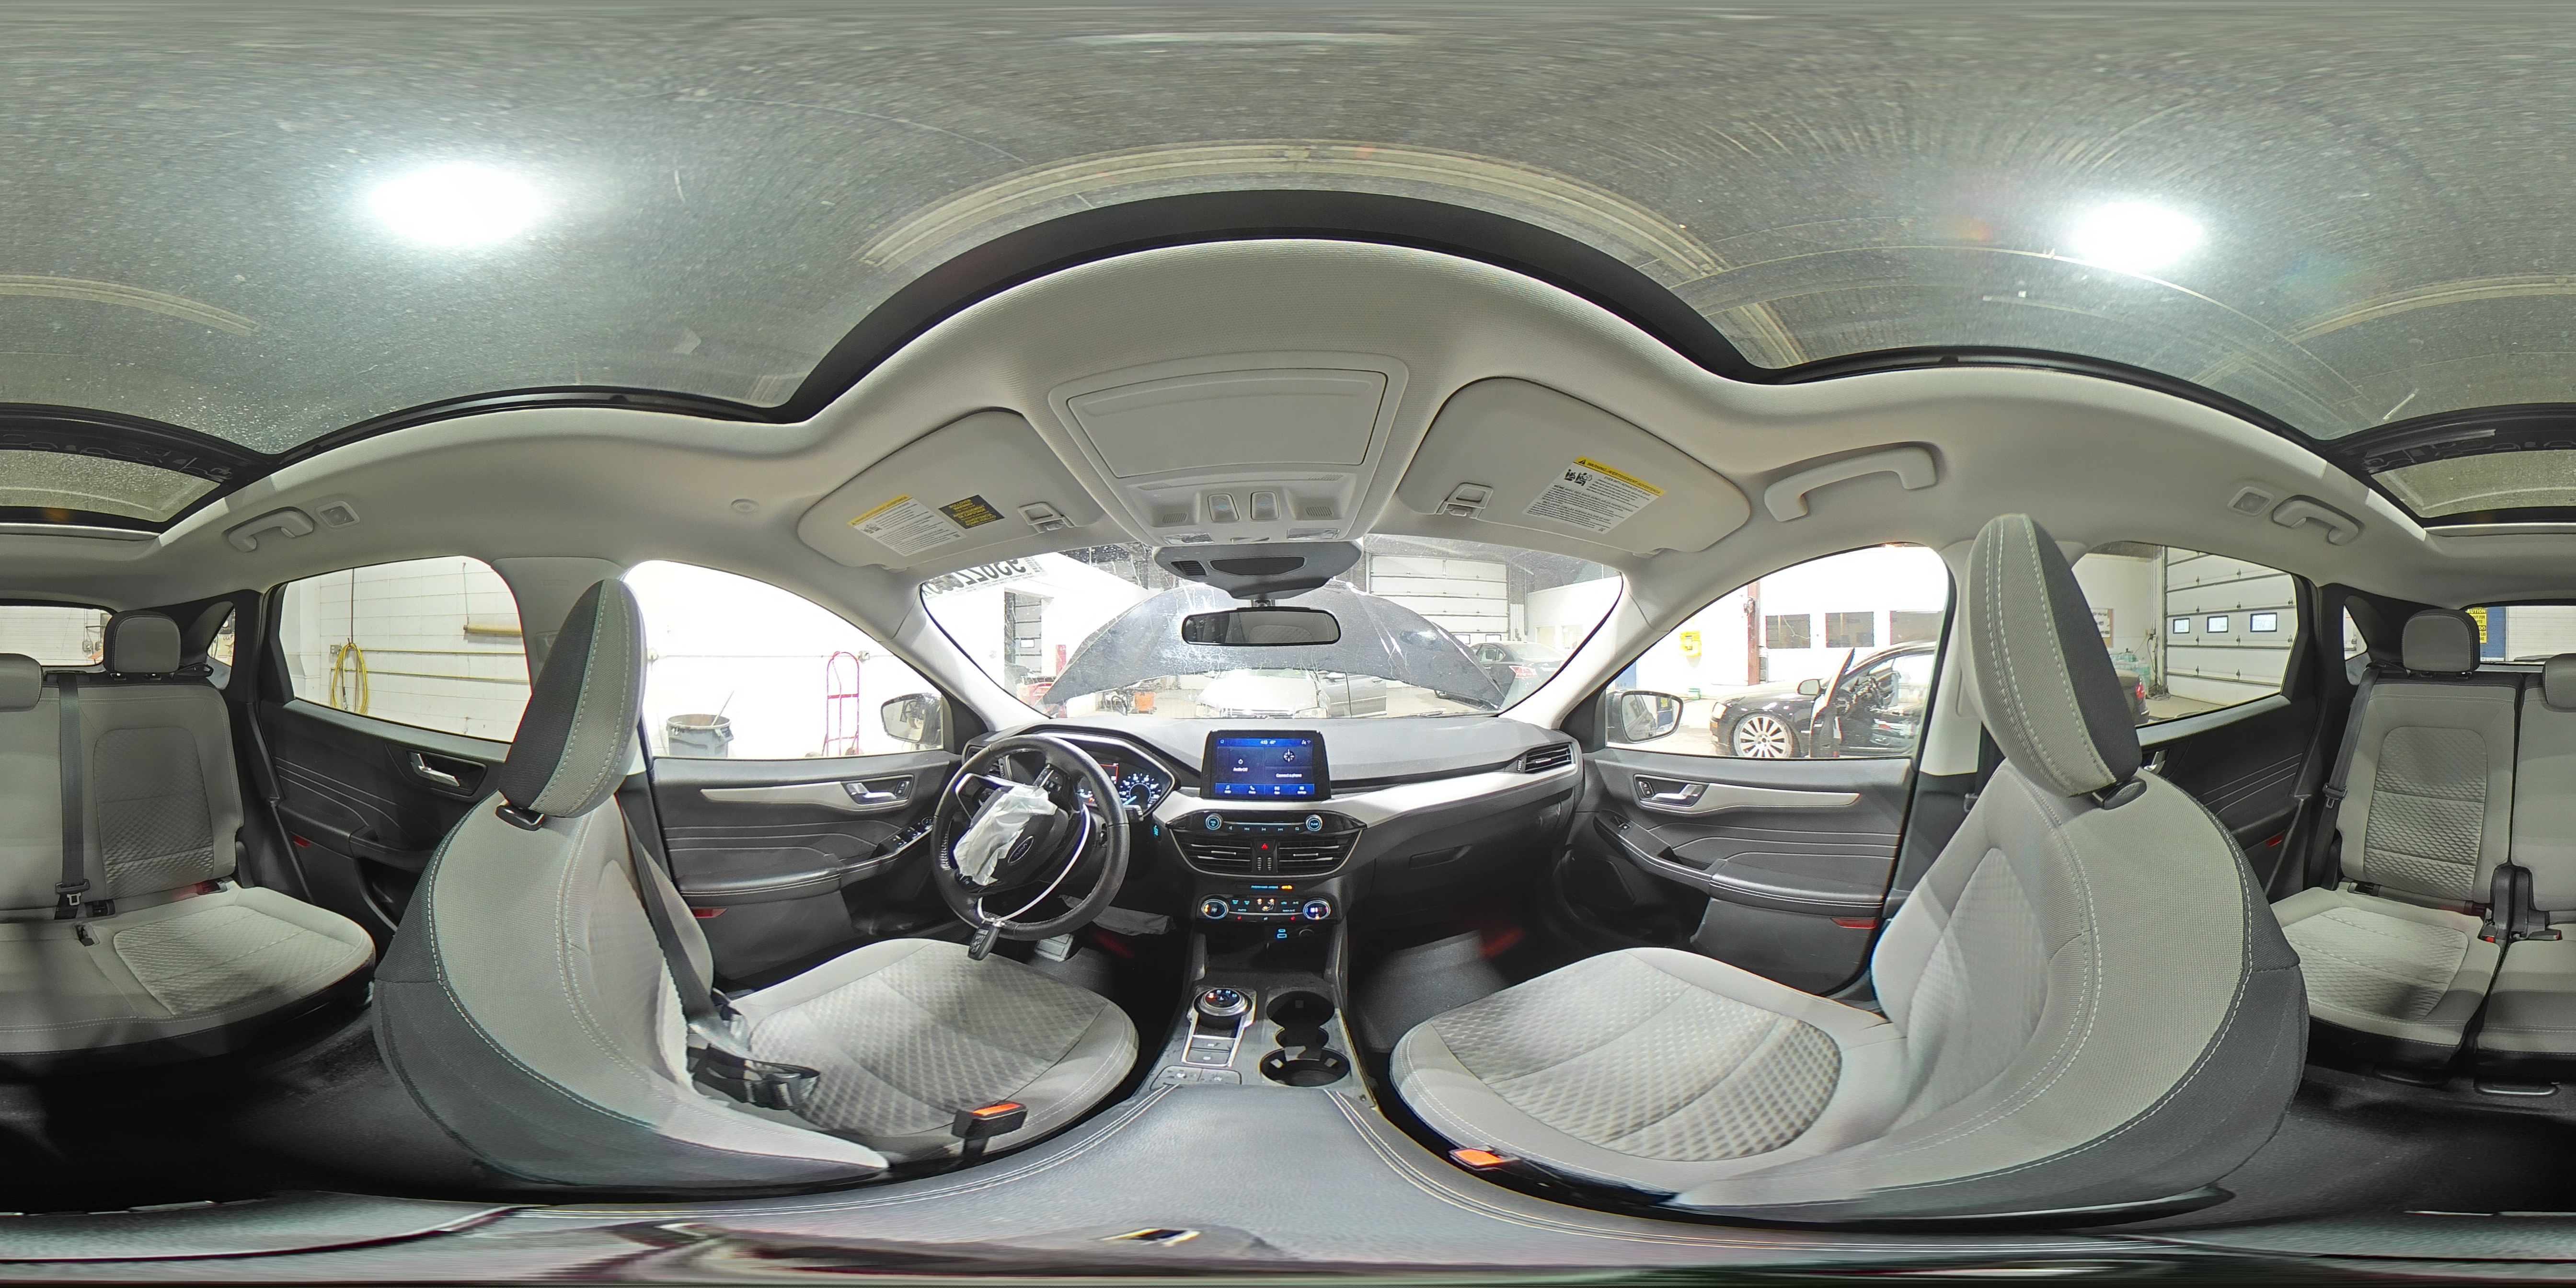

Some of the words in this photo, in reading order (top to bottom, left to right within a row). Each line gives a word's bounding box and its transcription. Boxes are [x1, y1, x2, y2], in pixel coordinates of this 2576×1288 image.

[1587, 462, 1606, 471] WARNING
[949, 499, 971, 508] ROLLOVER
[953, 505, 985, 517] AVERTISSEMENT
[964, 508, 986, 517] CAPOTAGE
[965, 513, 992, 523] ADVERTENCIA
